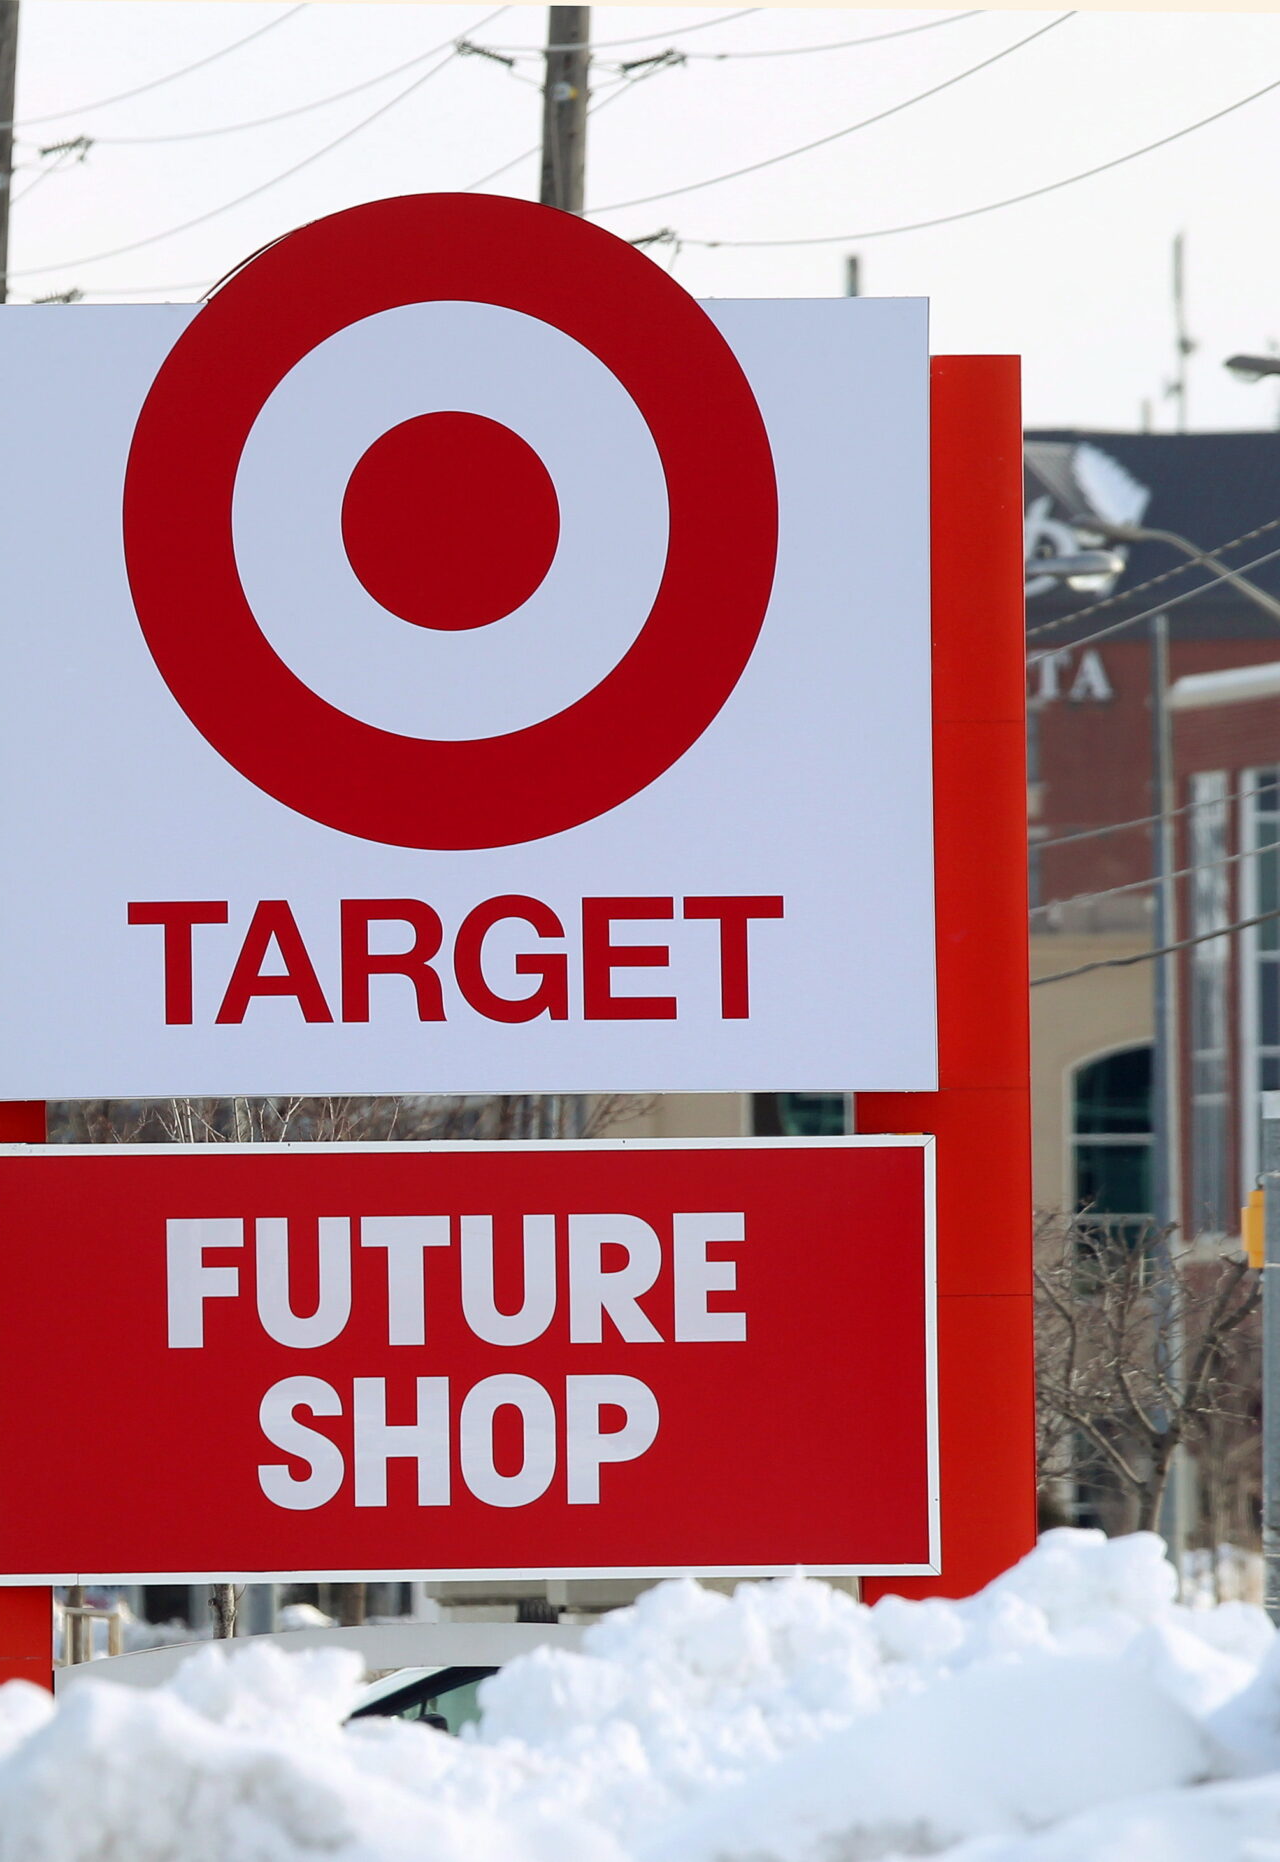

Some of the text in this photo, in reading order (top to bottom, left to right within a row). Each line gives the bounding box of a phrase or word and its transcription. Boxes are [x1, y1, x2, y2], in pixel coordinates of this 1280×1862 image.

[128, 895, 784, 1025] TARGET
[166, 1212, 747, 1349] FUTURE
[257, 1373, 660, 1511] SHOP
